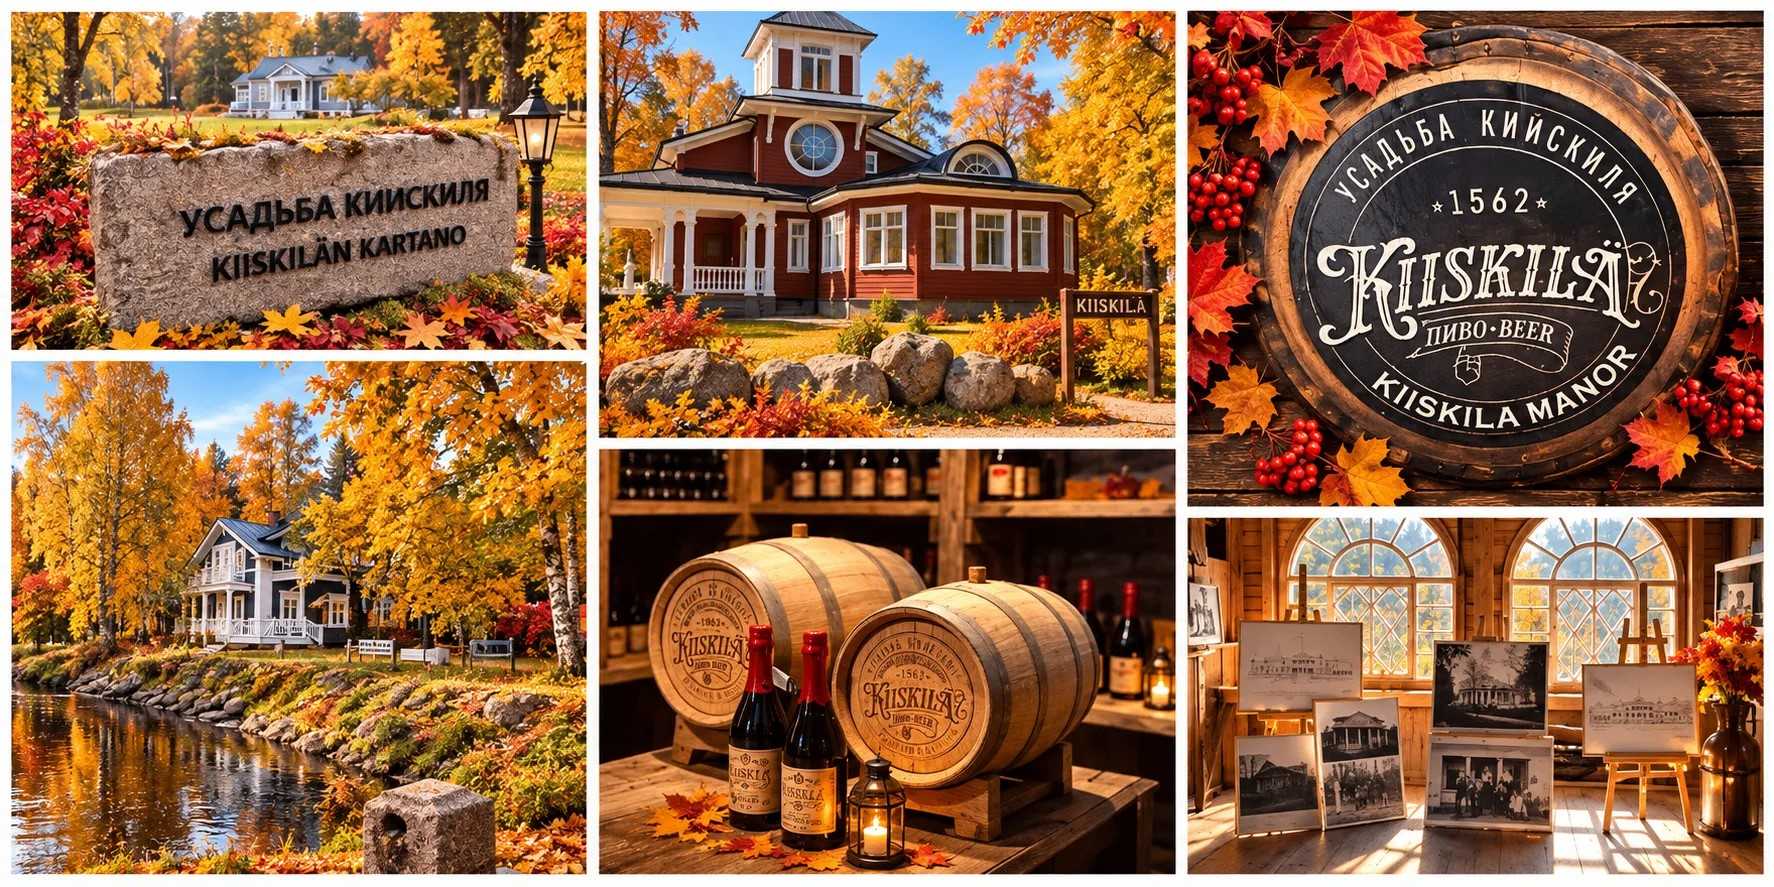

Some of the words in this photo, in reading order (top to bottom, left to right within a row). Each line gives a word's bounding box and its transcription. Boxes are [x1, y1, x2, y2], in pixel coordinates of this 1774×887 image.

[1334, 112, 1455, 203] УСАДЬБА
[1481, 109, 1638, 204] КИЙСКИЛЯ
[180, 195, 336, 238] УСАДЬБА
[1448, 186, 1530, 215] 1562
[211, 236, 351, 283] KIISKILÄN
[360, 225, 467, 259] KARTANO
[1317, 236, 1642, 345] KIISKILÄ
[1371, 370, 1520, 429] KIISKILA
[1527, 343, 1639, 424] MANOR
